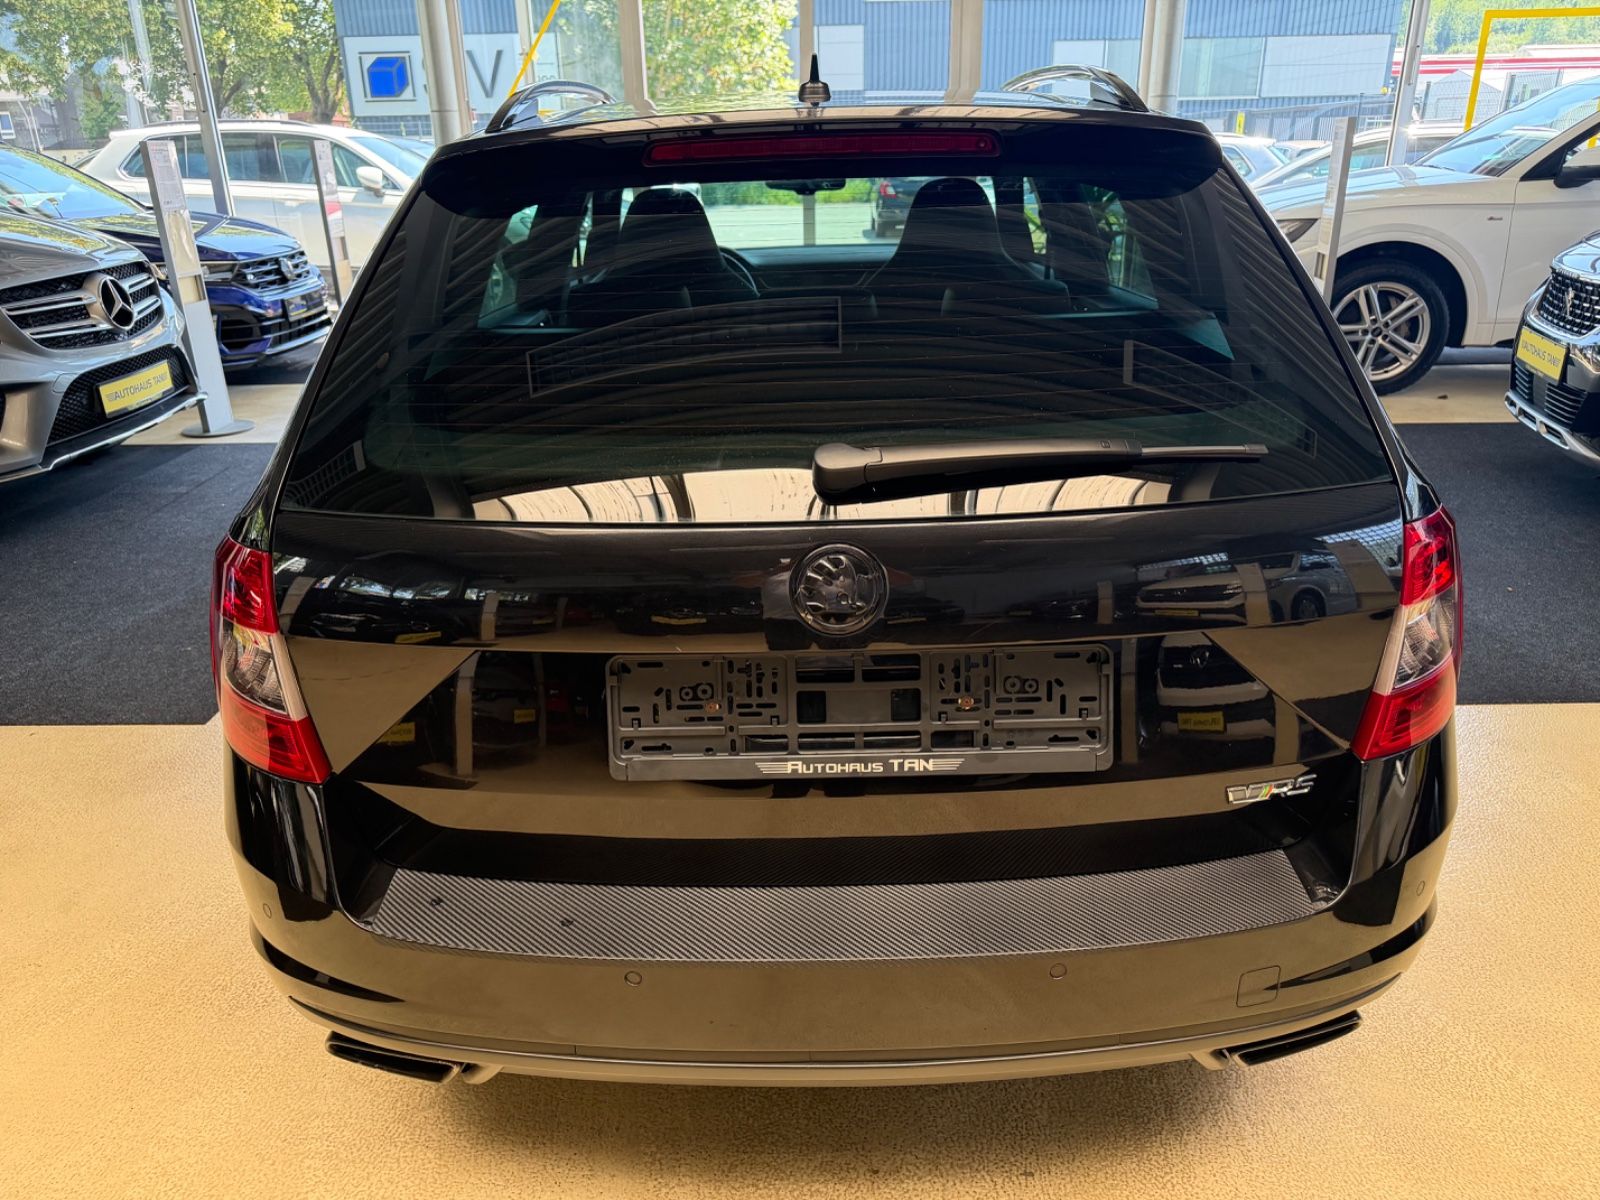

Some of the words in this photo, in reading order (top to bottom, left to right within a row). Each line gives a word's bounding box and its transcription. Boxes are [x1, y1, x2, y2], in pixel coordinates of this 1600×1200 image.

[114, 378, 153, 400] AUTOHAUS
[788, 760, 884, 774] AUTOHAUS
[888, 758, 934, 772] TAN
